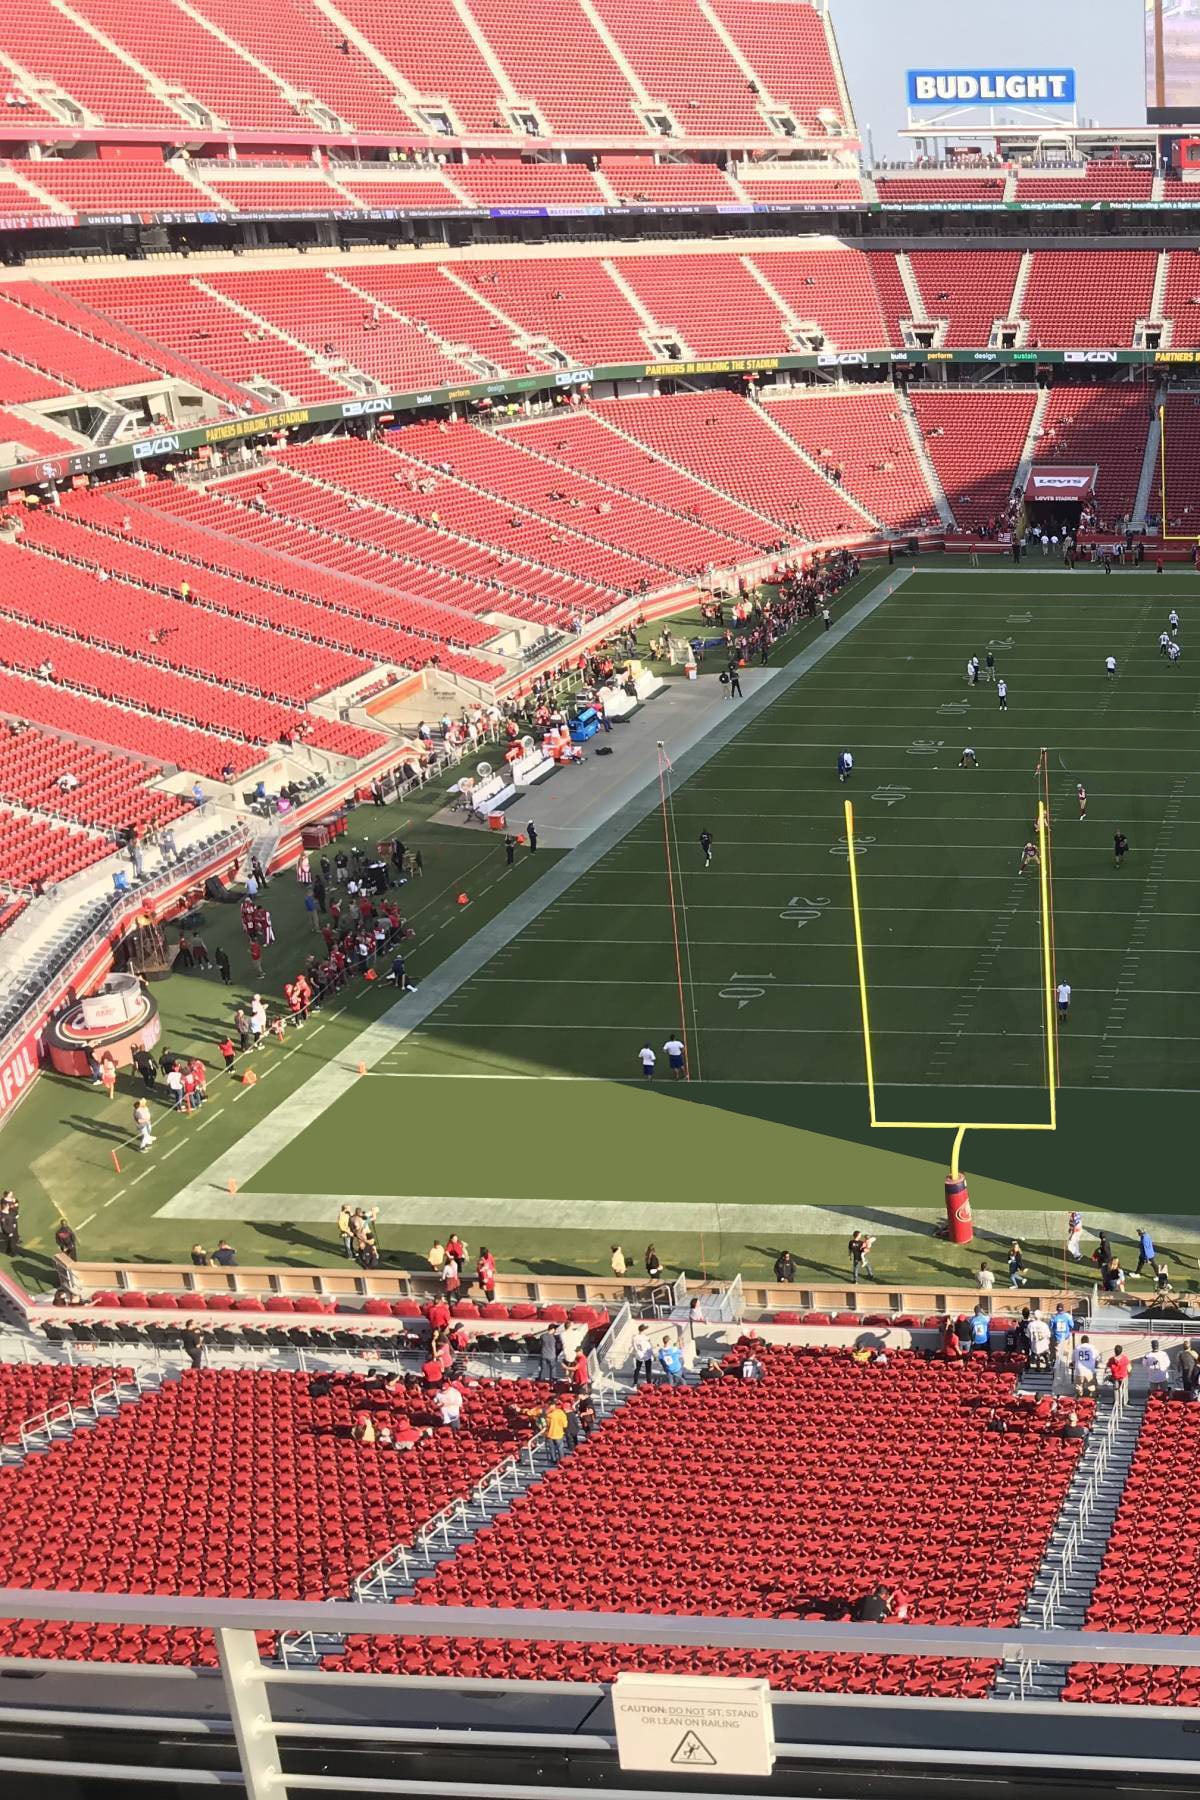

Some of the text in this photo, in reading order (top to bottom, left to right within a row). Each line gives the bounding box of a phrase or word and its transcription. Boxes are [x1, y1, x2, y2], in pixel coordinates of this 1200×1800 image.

[917, 75, 1067, 99] BUD LIGHT
[33, 216, 74, 228] STADIUM
[891, 352, 907, 360] build
[928, 353, 953, 361] perform
[974, 353, 996, 361] design
[1155, 352, 1193, 362] PARTNERS
[645, 358, 778, 375] PARTNERS IN BUILDING THE STADIUM
[487, 384, 505, 394] design
[417, 395, 432, 404] build
[206, 410, 309, 442] PARTNERS IN BUILDING THE STADIUM
[779, 896, 831, 919] 20
[718, 972, 776, 998] 10
[620, 1704, 759, 1719] CAUTION: DO NOT SIT, STAND
[641, 1716, 740, 1729] OR LEAN ON RAILING
